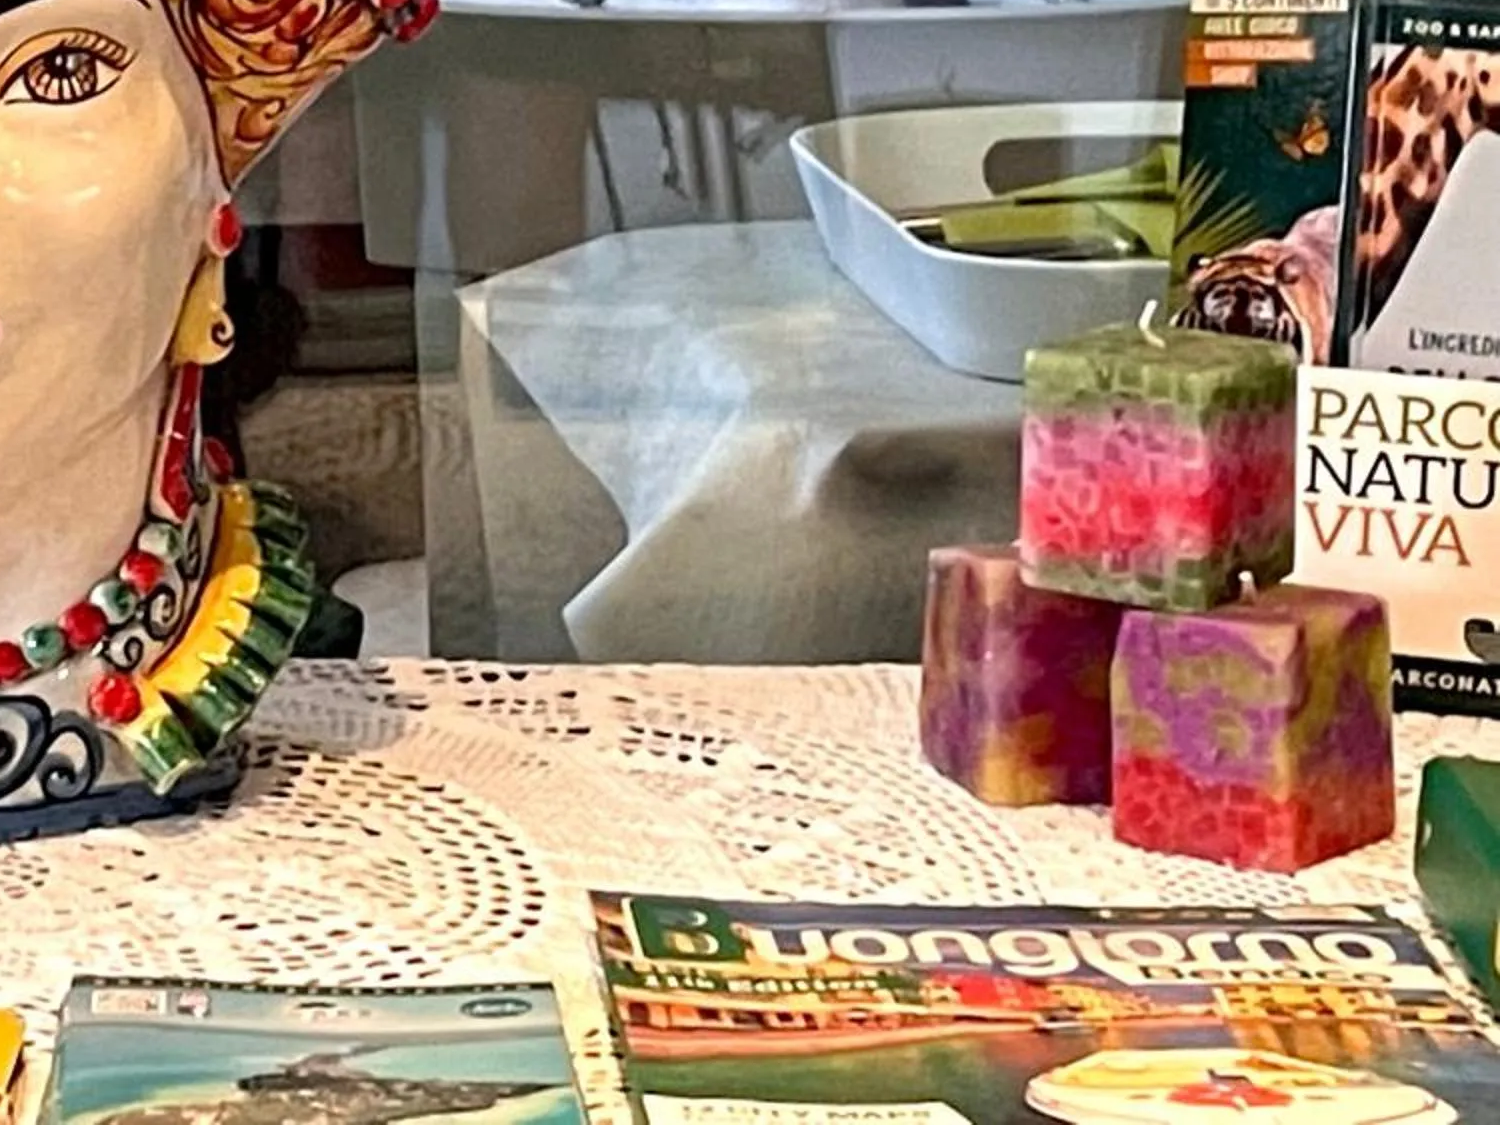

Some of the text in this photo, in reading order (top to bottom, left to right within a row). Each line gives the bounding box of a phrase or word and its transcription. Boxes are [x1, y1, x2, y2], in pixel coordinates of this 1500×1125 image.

[1307, 386, 1500, 451] PARC
[1303, 443, 1500, 510] NATU
[1302, 500, 1473, 567] VIVA
